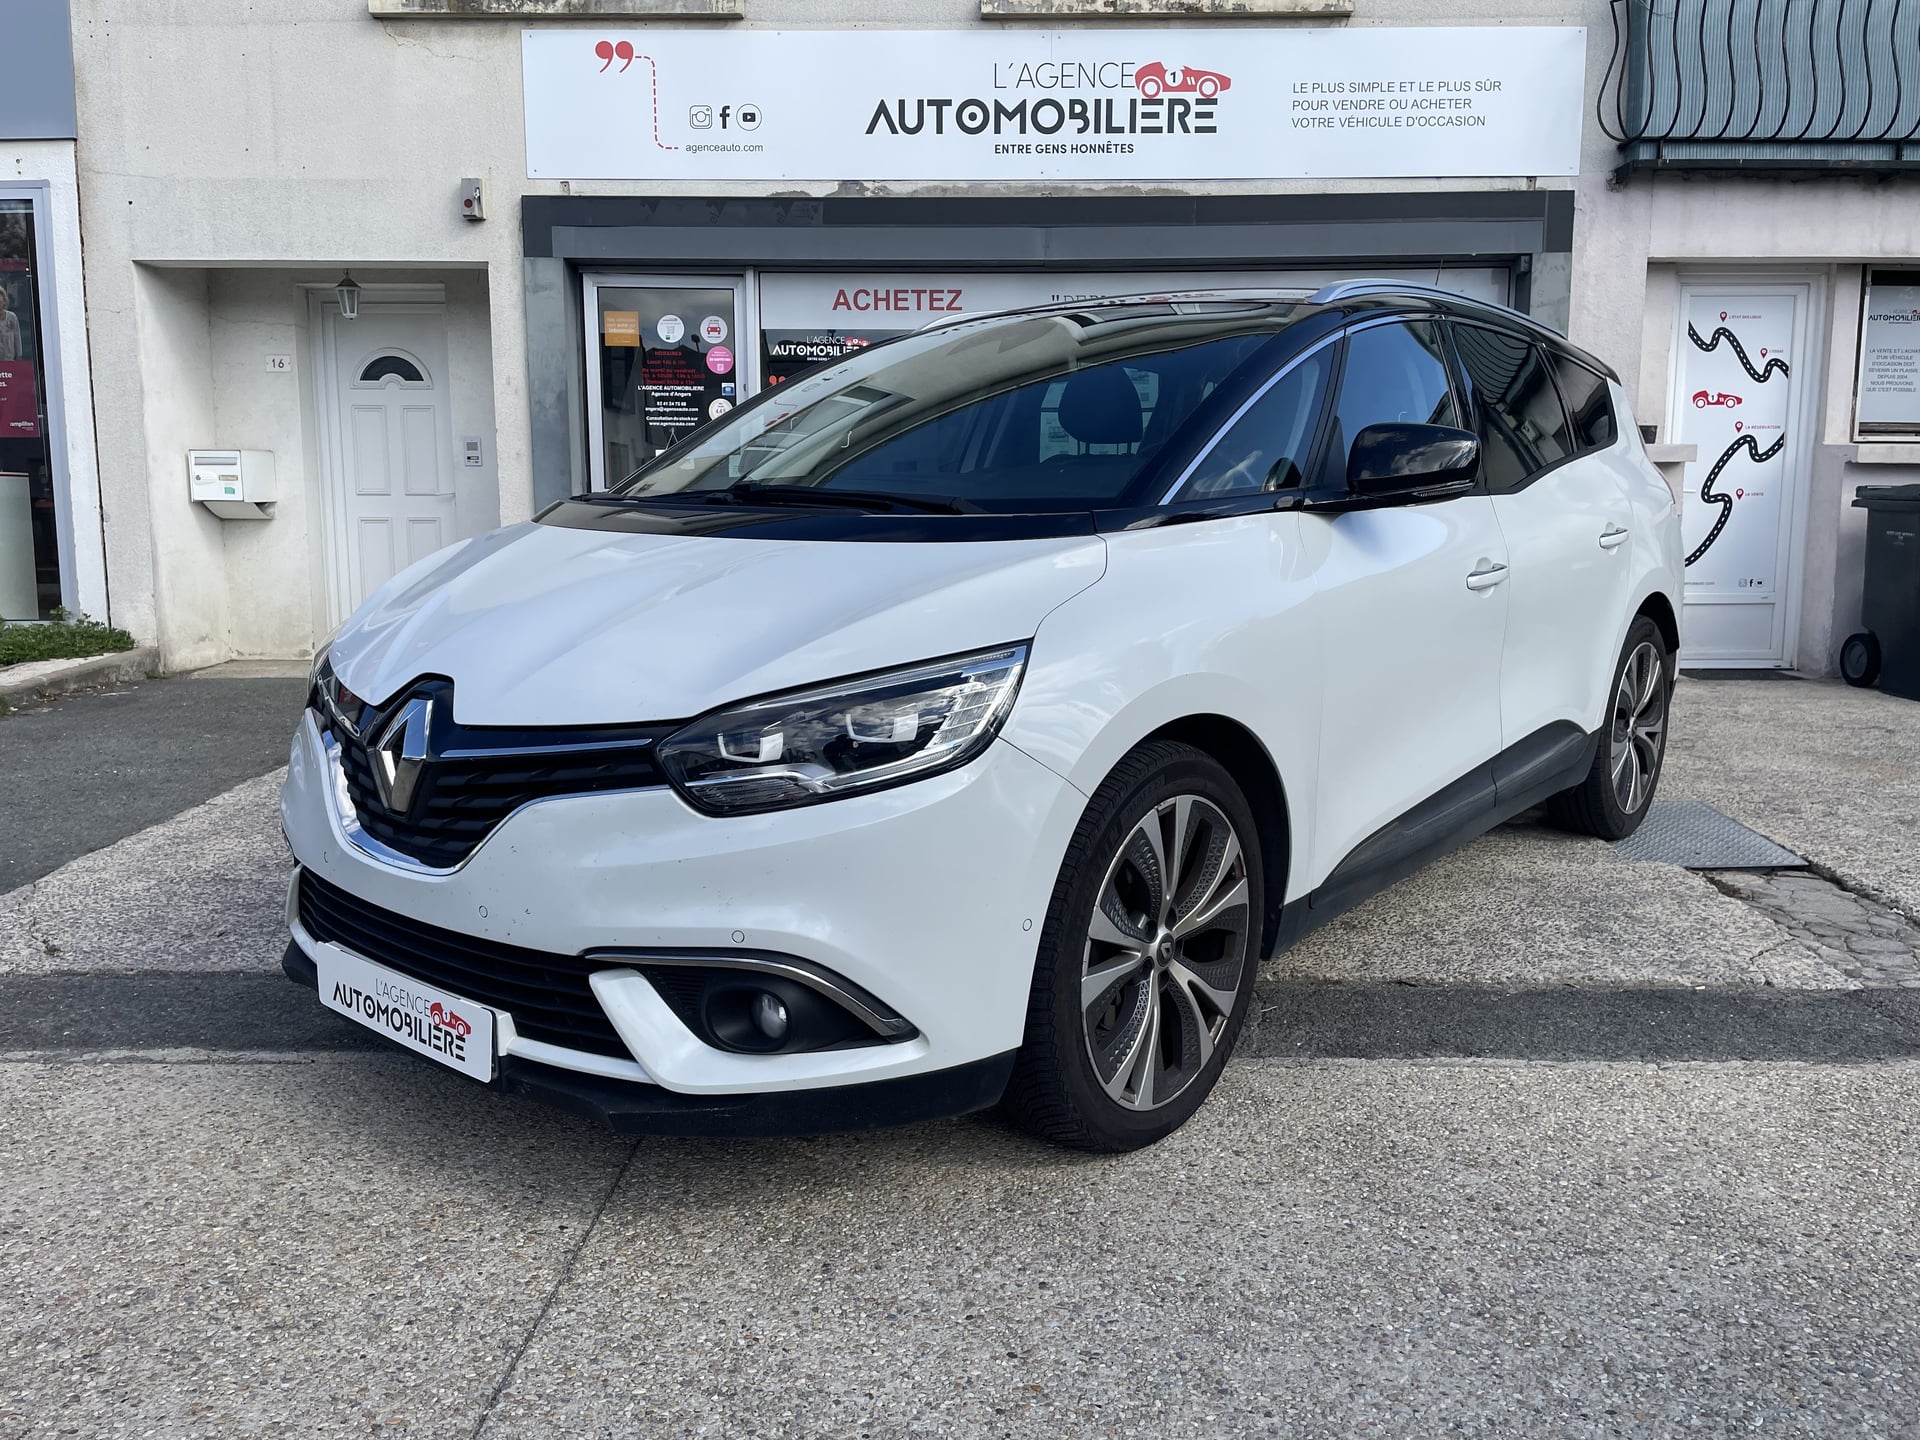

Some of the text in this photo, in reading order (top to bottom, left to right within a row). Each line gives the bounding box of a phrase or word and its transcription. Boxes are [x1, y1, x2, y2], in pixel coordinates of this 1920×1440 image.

[994, 62, 1136, 89] L'AGENCE
[1293, 78, 1503, 94] LE PLUS SIMPLE ET LE PLUS SÛR
[1292, 98, 1473, 111] POUR VENDRE OU ACHETER
[1292, 114, 1487, 129] VOTRE VÉHICULE D'OCCASION
[685, 143, 764, 154] agenceauto.com
[994, 141, 1134, 154] ENTRE GENS HONNÊTES
[831, 288, 963, 311] ACHETEZ
[806, 335, 846, 345] L'AGENCE
[272, 358, 285, 369] 16
[375, 977, 431, 1018] L'AGENCE
